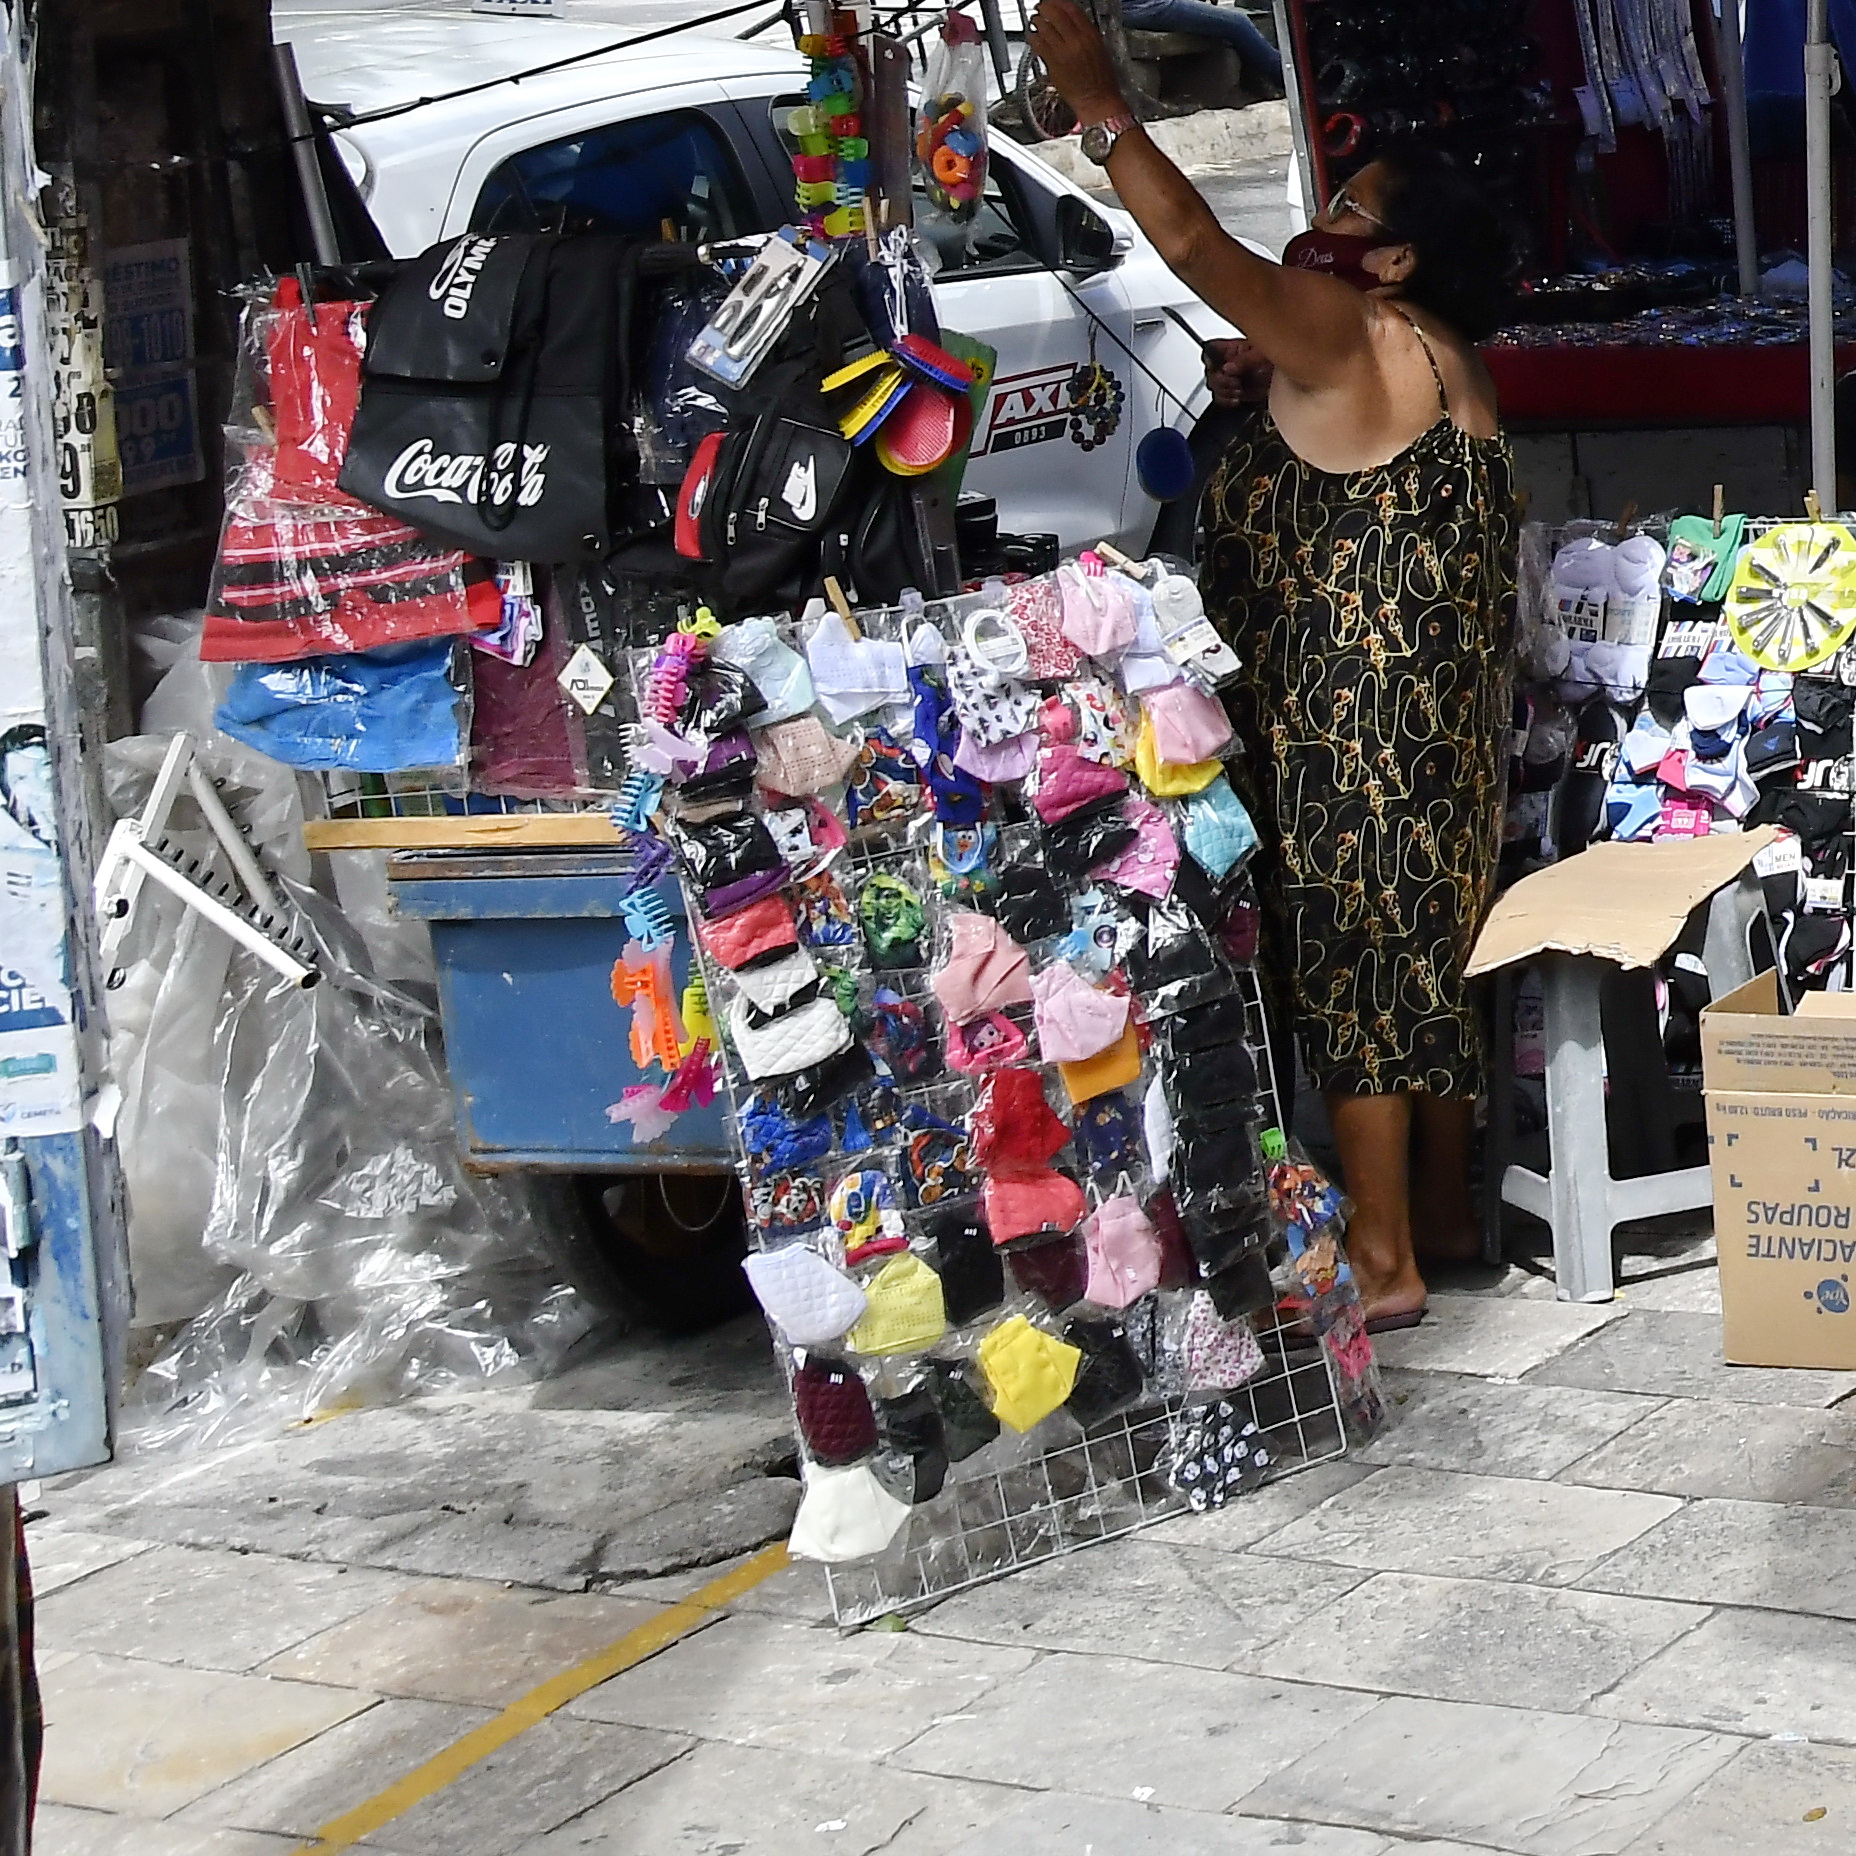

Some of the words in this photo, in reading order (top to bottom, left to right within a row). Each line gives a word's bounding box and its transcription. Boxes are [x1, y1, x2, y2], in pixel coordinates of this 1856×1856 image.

[1014, 426, 1047, 445] 0893
[1774, 852, 1796, 864] MEN
[1786, 1107, 1808, 1118] PESO
[1831, 1146, 1856, 1170] 2L
[1746, 1200, 1851, 1230] ROUPAS
